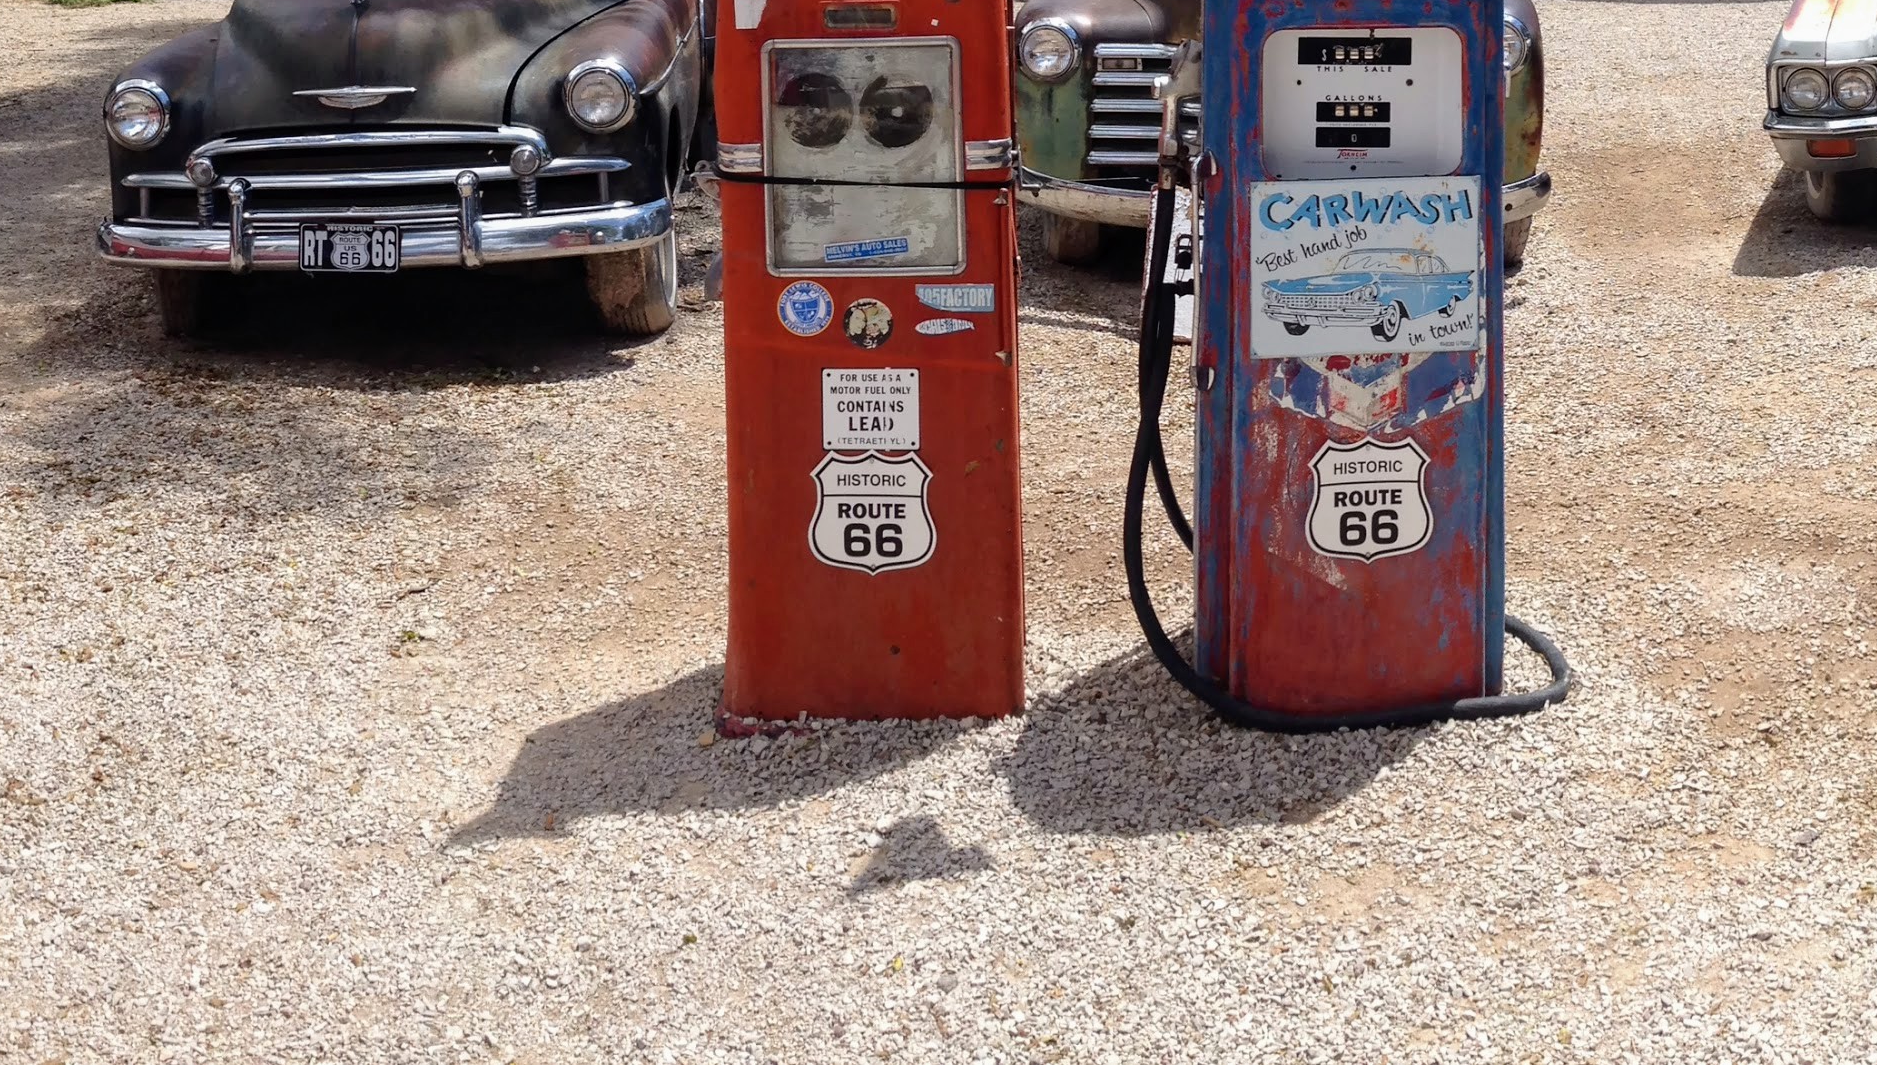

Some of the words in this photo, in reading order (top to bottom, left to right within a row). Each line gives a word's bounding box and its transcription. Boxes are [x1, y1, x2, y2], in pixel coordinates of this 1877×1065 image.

[1316, 65, 1344, 73] THIS
[1364, 65, 1393, 73] SALE
[1325, 94, 1383, 102] GALLONS
[1258, 189, 1474, 232] CARWASH
[304, 230, 328, 267] RT
[371, 230, 396, 267] 66
[861, 241, 883, 253] AUTO
[883, 238, 907, 249] SALES
[1300, 234, 1343, 260] hand
[1343, 225, 1368, 249] job
[339, 252, 361, 266] 66
[1407, 332, 1426, 347] in
[840, 374, 858, 382] FOR
[861, 374, 878, 382] USE
[881, 374, 893, 382] AS
[895, 374, 902, 382] A
[830, 386, 861, 395] MOTOR
[865, 386, 886, 395] FUEL
[890, 386, 911, 395] ONLY
[837, 400, 905, 413] CONTAINS
[1333, 460, 1403, 475] HISTORIC
[836, 474, 907, 487] HISTORIC
[1333, 489, 1403, 508] ROUTE
[837, 503, 907, 519] ROUTE
[1339, 509, 1399, 547] 66
[843, 523, 903, 558] 66
